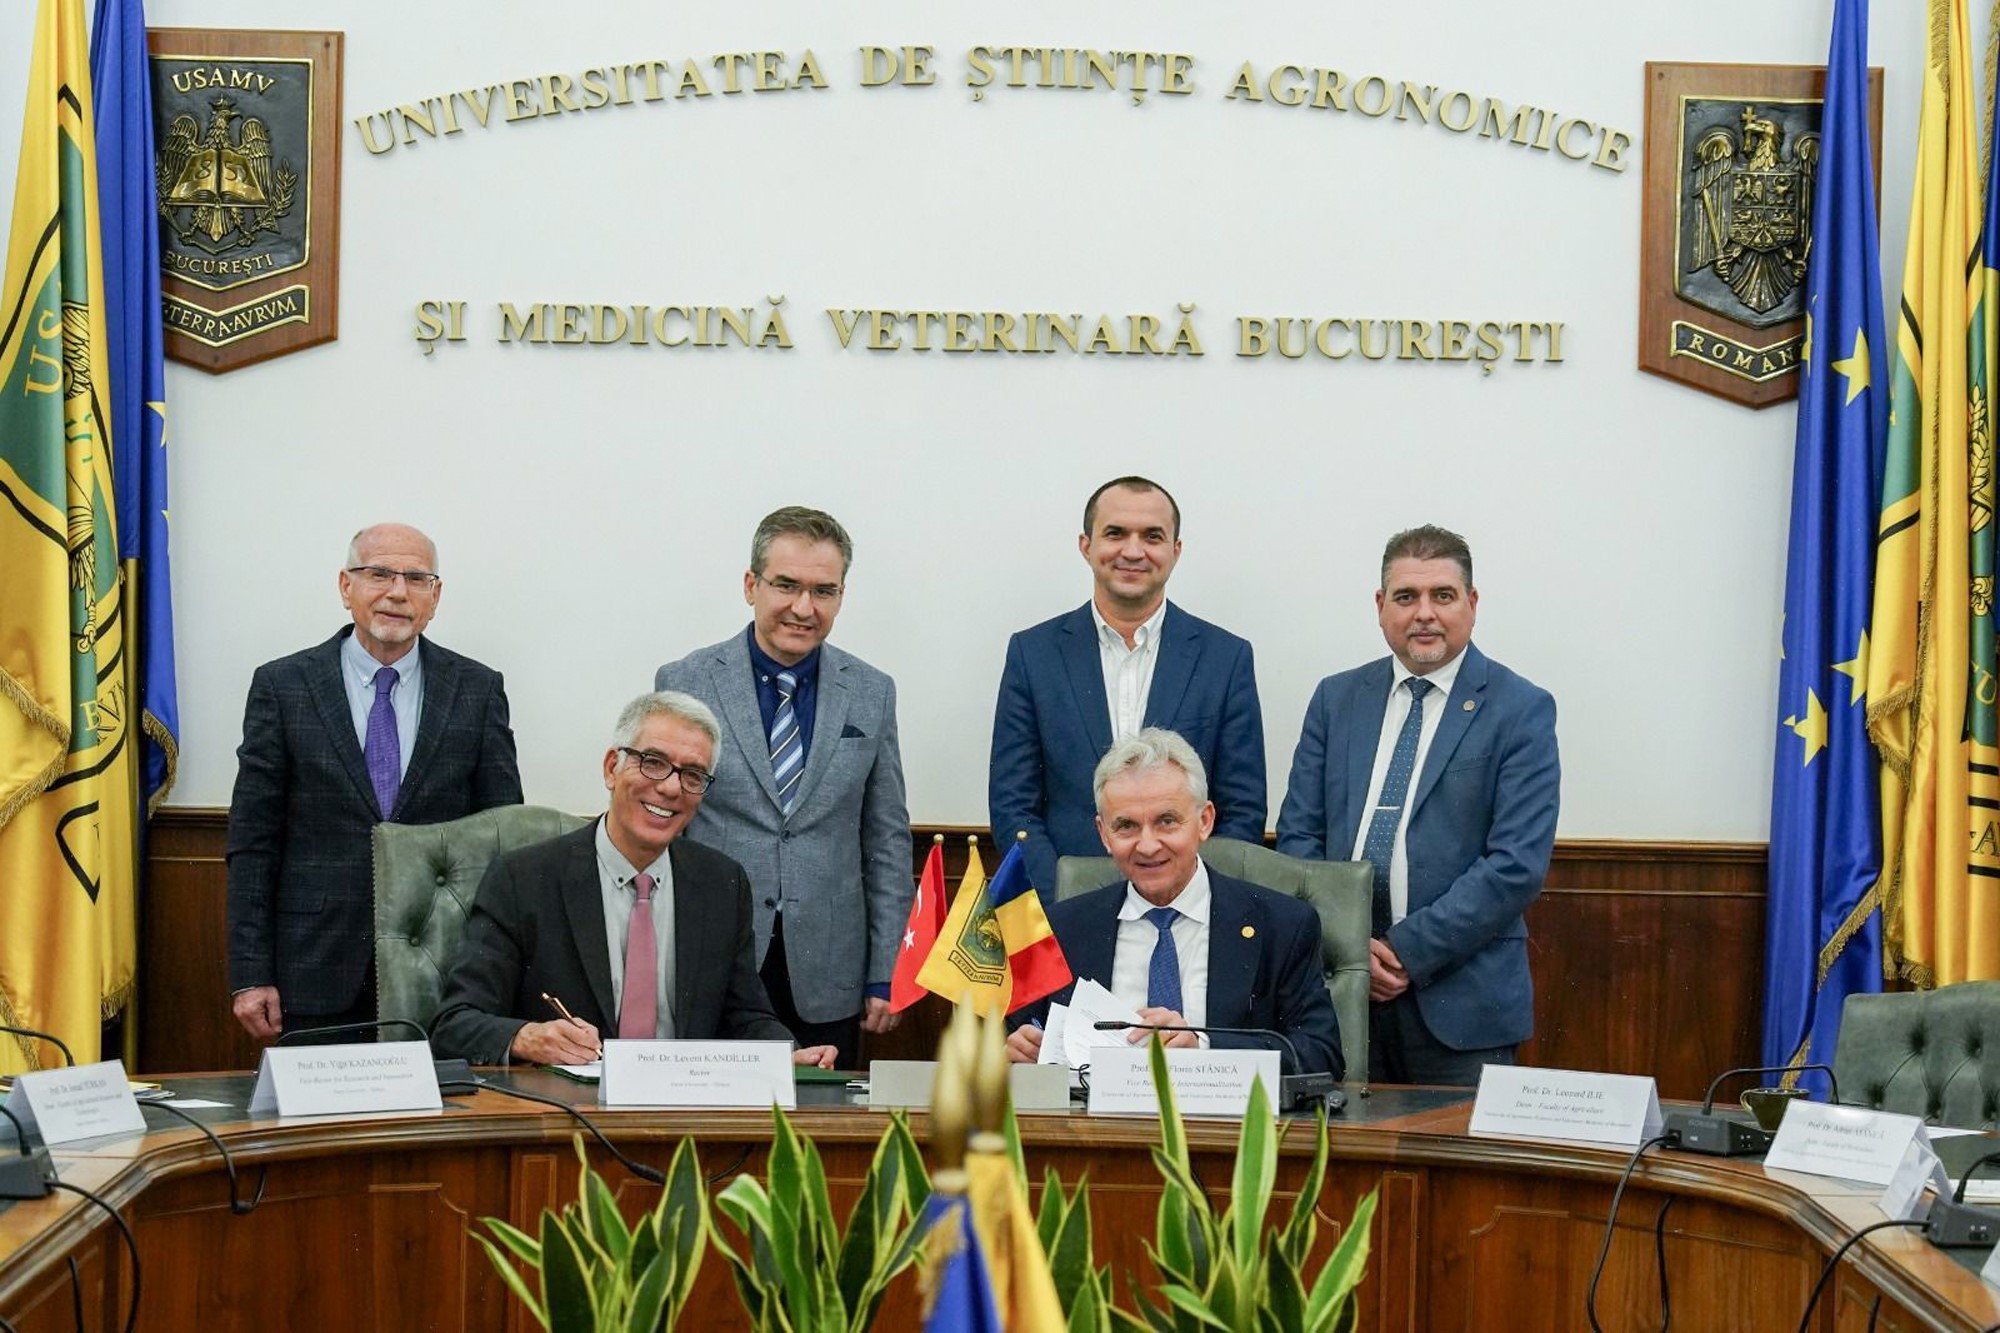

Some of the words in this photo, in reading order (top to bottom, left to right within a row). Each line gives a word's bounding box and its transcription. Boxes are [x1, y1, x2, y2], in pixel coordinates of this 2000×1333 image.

[172, 68, 274, 94] USAMV
[354, 48, 829, 155] UNIVERSITATEA
[859, 46, 937, 86] DE
[1226, 60, 1634, 173] AGRONOMICE
[415, 300, 467, 356] ȘI
[498, 294, 794, 348] MEDICINĂ
[826, 302, 1204, 356] VETERINARĂ
[1236, 316, 1565, 376] BUCUREȘTI
